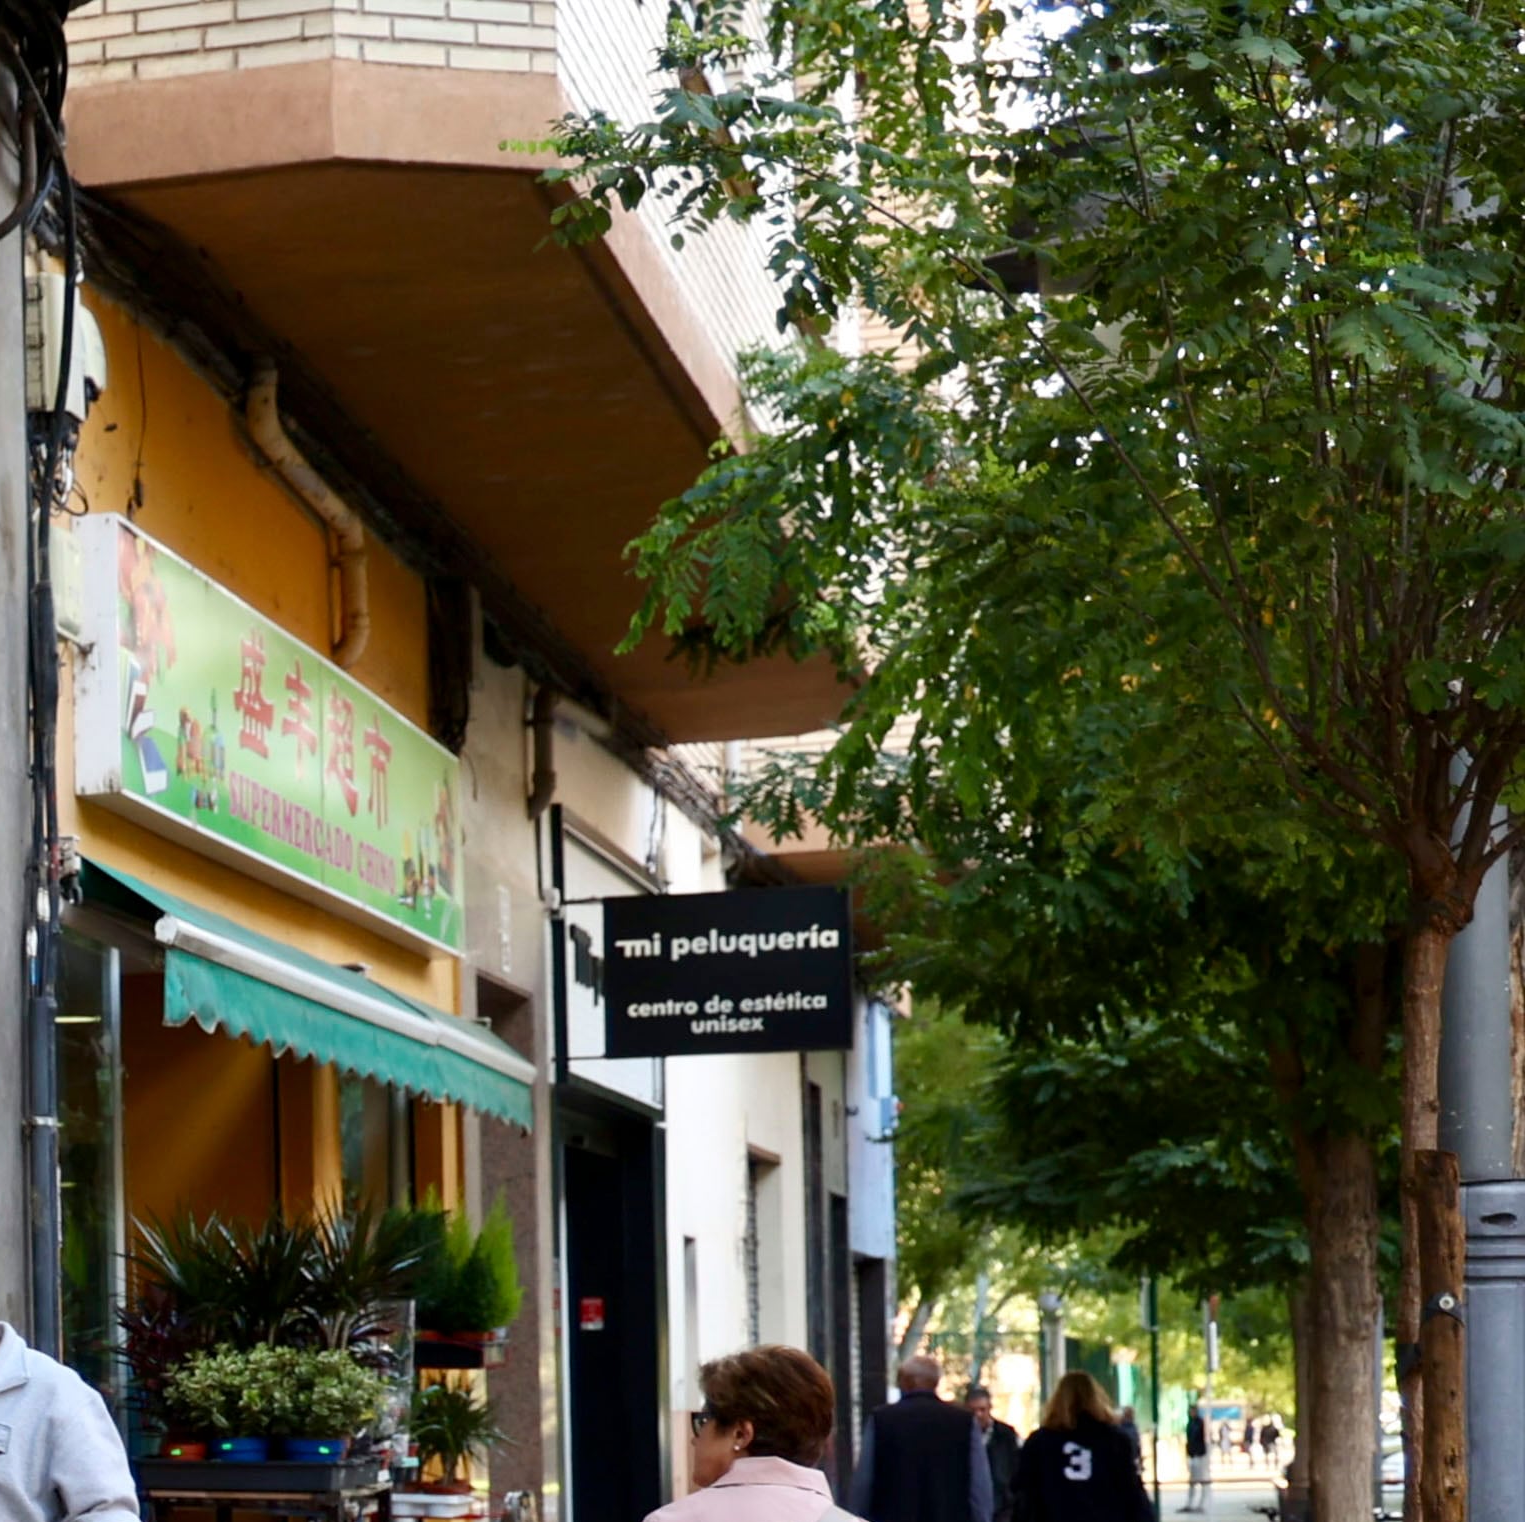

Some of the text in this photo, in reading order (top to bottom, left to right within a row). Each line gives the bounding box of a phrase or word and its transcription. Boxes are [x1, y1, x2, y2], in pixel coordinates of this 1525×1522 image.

[232, 623, 393, 831] 盛丰超市
[228, 771, 354, 873] SUPERMERCADO
[615, 922, 839, 961] mi peluquería
[627, 991, 827, 1018] centro de estética
[690, 1015, 764, 1034] unisex
[1063, 1441, 1092, 1480] 3
